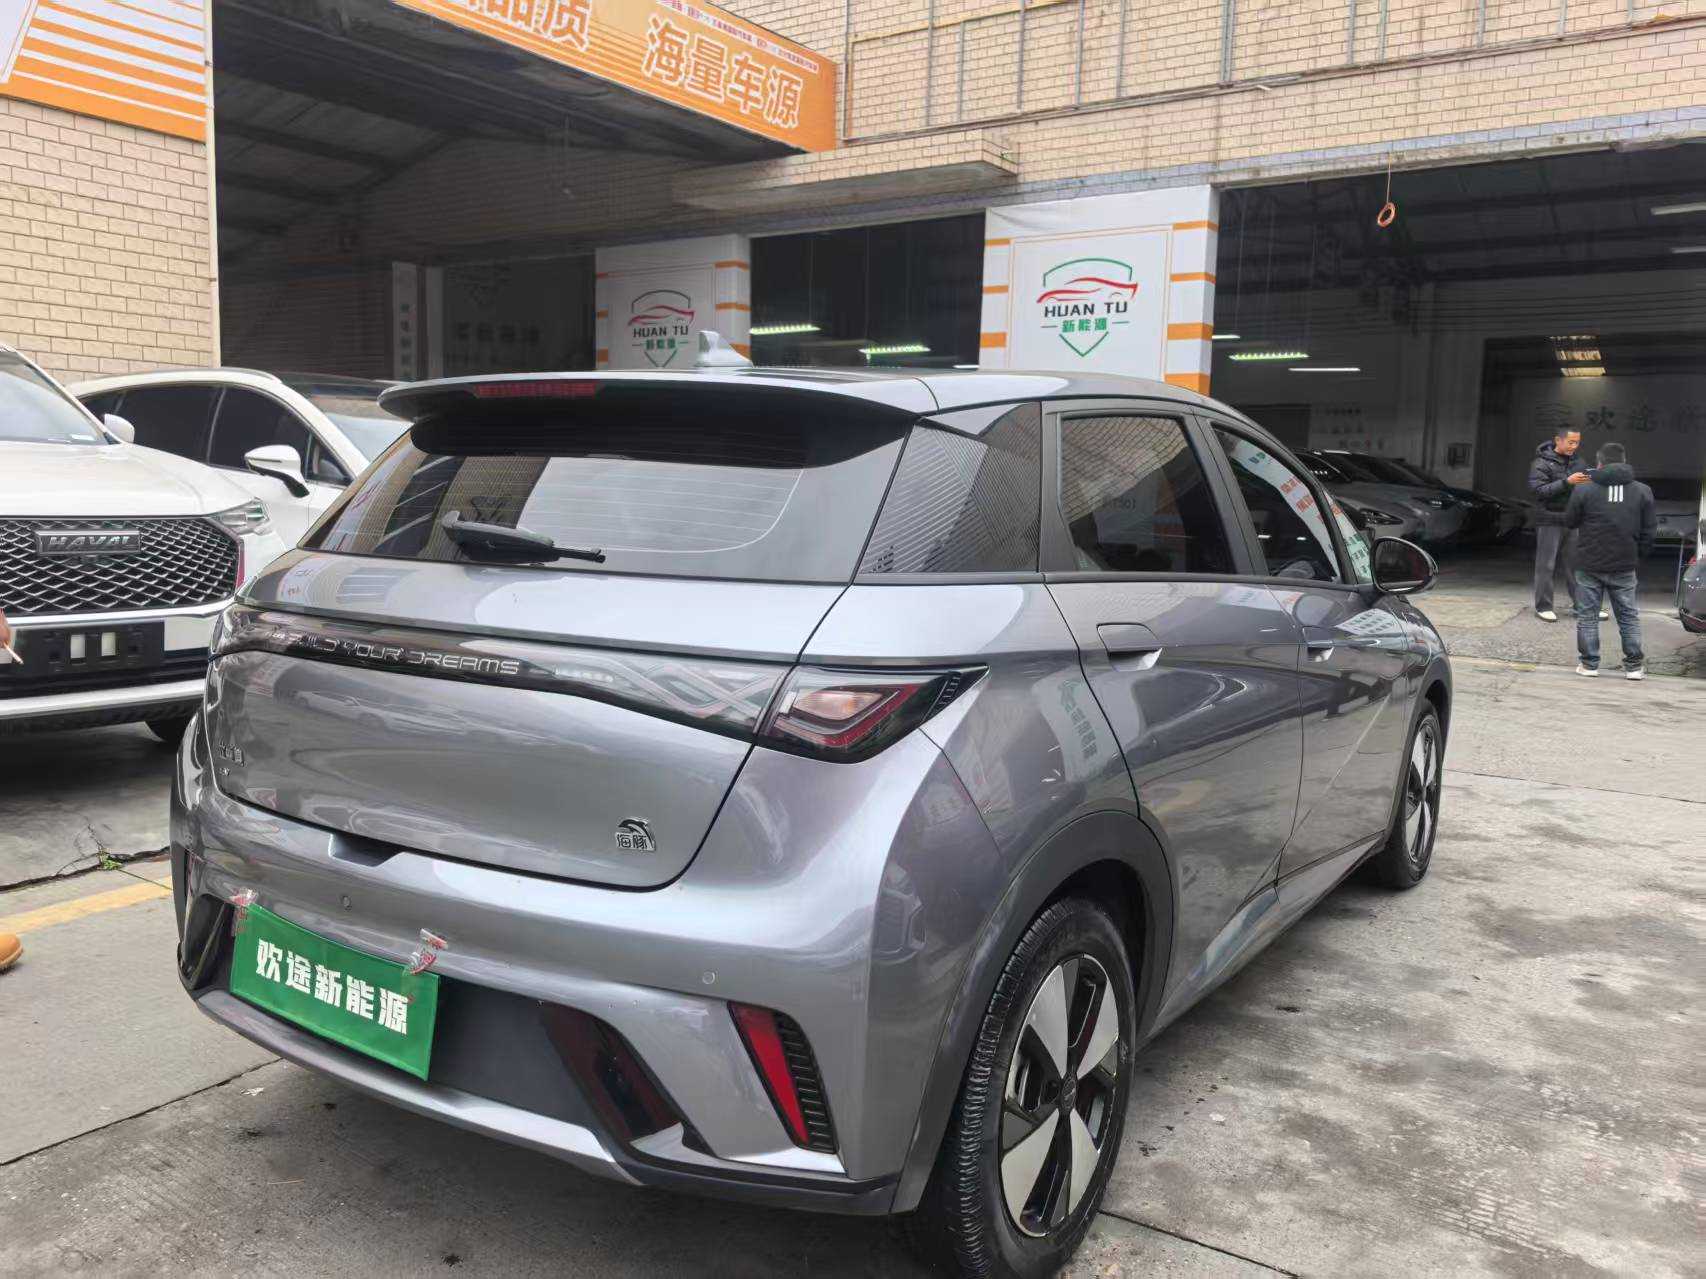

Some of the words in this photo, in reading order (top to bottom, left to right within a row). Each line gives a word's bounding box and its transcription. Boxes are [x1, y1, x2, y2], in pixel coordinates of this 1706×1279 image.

[641, 13, 804, 129] 海量车源
[1044, 304, 1095, 318] HUAN
[1104, 301, 1128, 314] TU
[633, 327, 667, 338] HUAN
[673, 325, 689, 336] TU
[408, 650, 520, 675] DREAMS
[256, 938, 409, 1036] 欢途新能源
